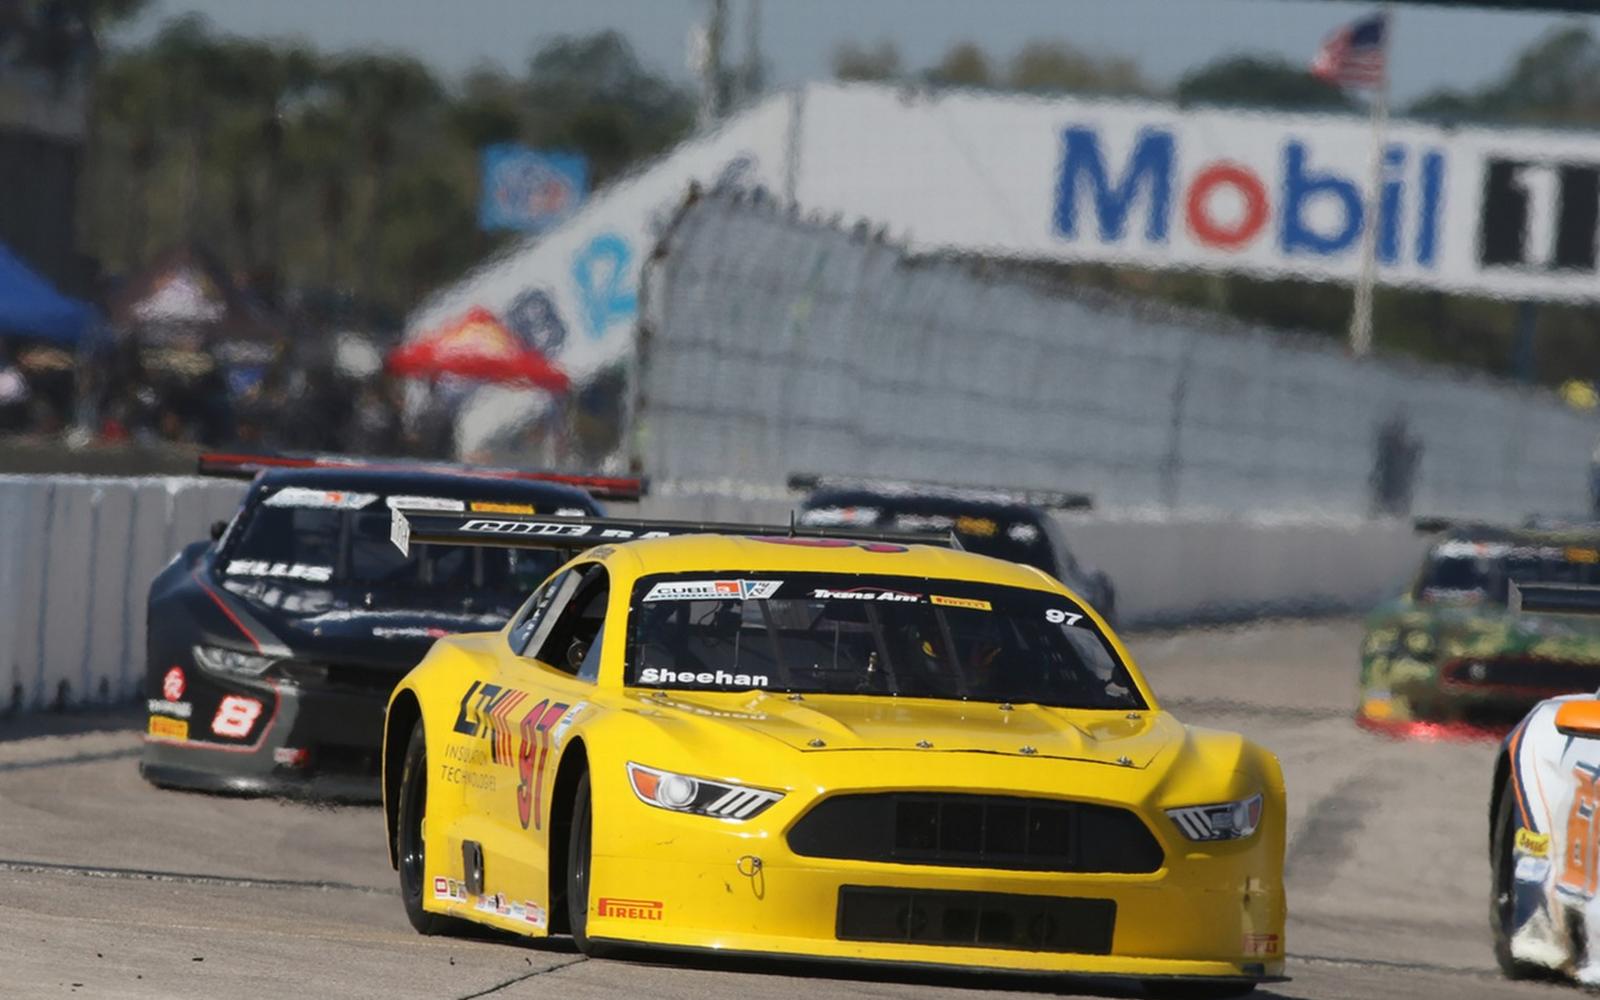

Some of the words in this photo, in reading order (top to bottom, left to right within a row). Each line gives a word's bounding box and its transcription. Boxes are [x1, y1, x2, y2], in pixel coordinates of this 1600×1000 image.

[1052, 122, 1446, 268] Mobil
[1513, 164, 1563, 266] 1
[226, 558, 334, 583] ELLIS
[813, 588, 876, 600] Trans
[876, 591, 918, 602] Am
[1045, 609, 1083, 626] 97
[641, 668, 768, 686] Sheehan
[210, 693, 264, 740] 8
[517, 698, 570, 830] 97
[598, 897, 664, 921] PIRELLI
